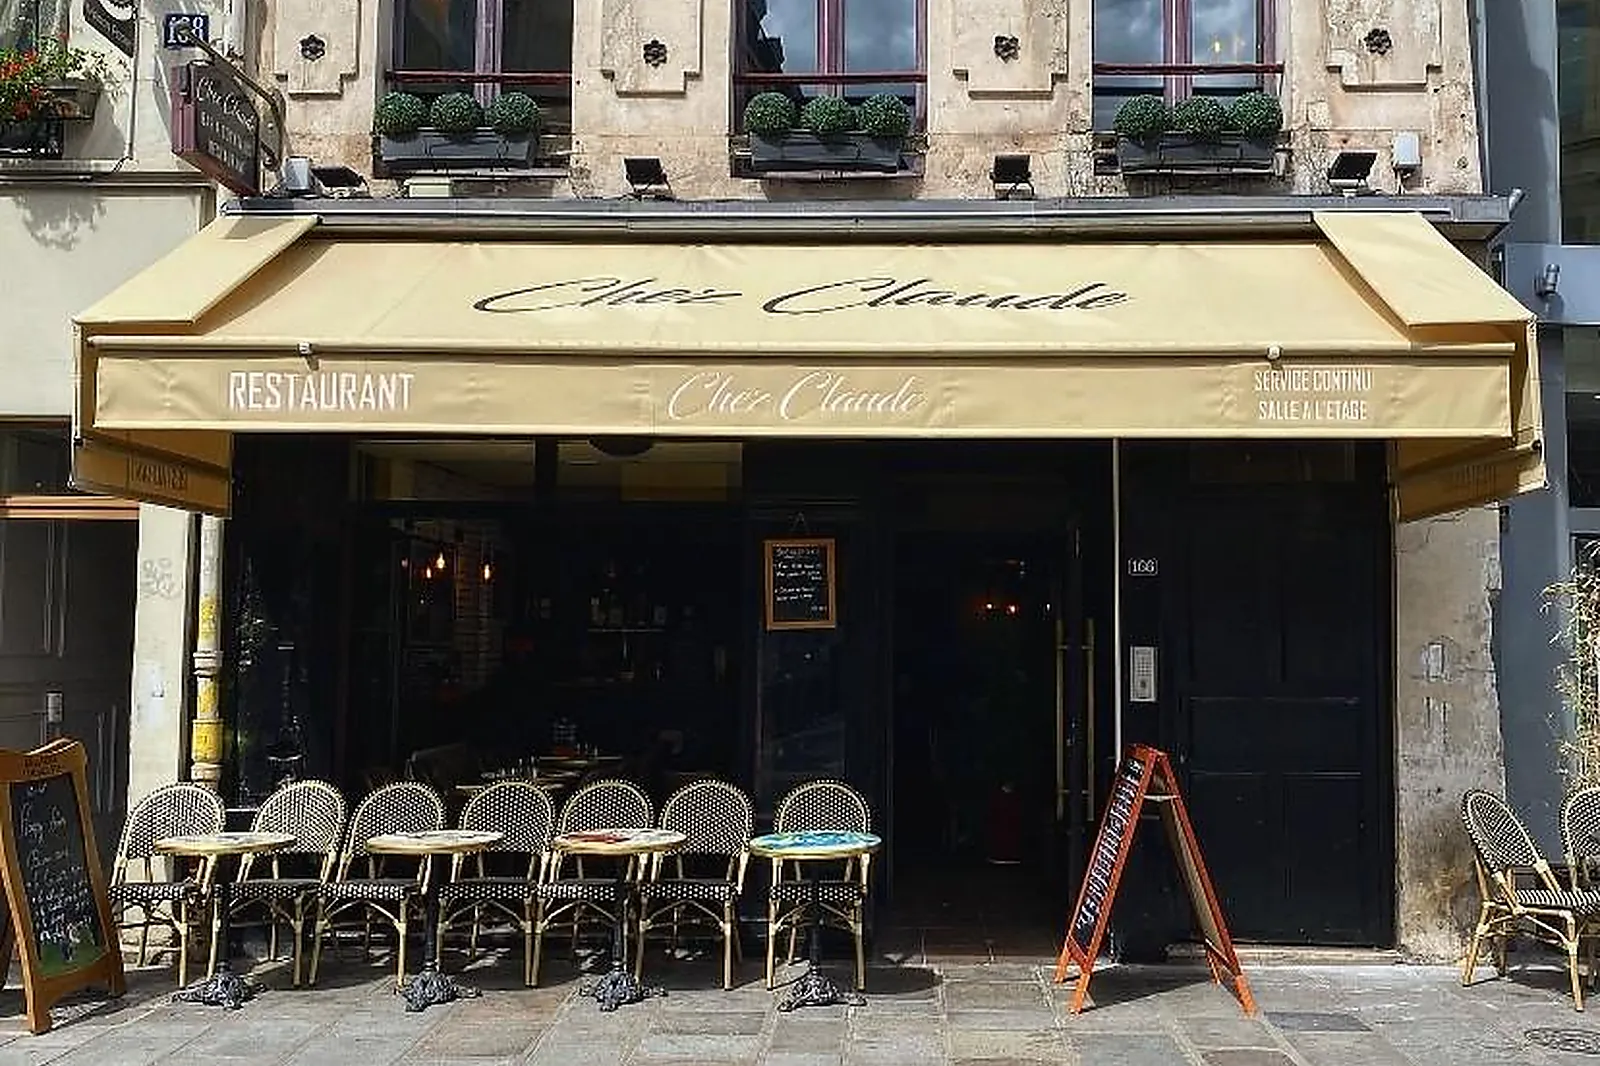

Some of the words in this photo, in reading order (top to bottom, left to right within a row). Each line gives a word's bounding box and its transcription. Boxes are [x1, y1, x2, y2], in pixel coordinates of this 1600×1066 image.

[472, 277, 742, 313] Chez
[762, 277, 1129, 315] Claude
[229, 371, 415, 411] RESTAURANT
[667, 371, 771, 420] Chez
[779, 370, 927, 420] Claude
[1255, 369, 1309, 392] SERVICE
[1313, 369, 1373, 392] CONTINU
[1259, 400, 1300, 420] SALLE
